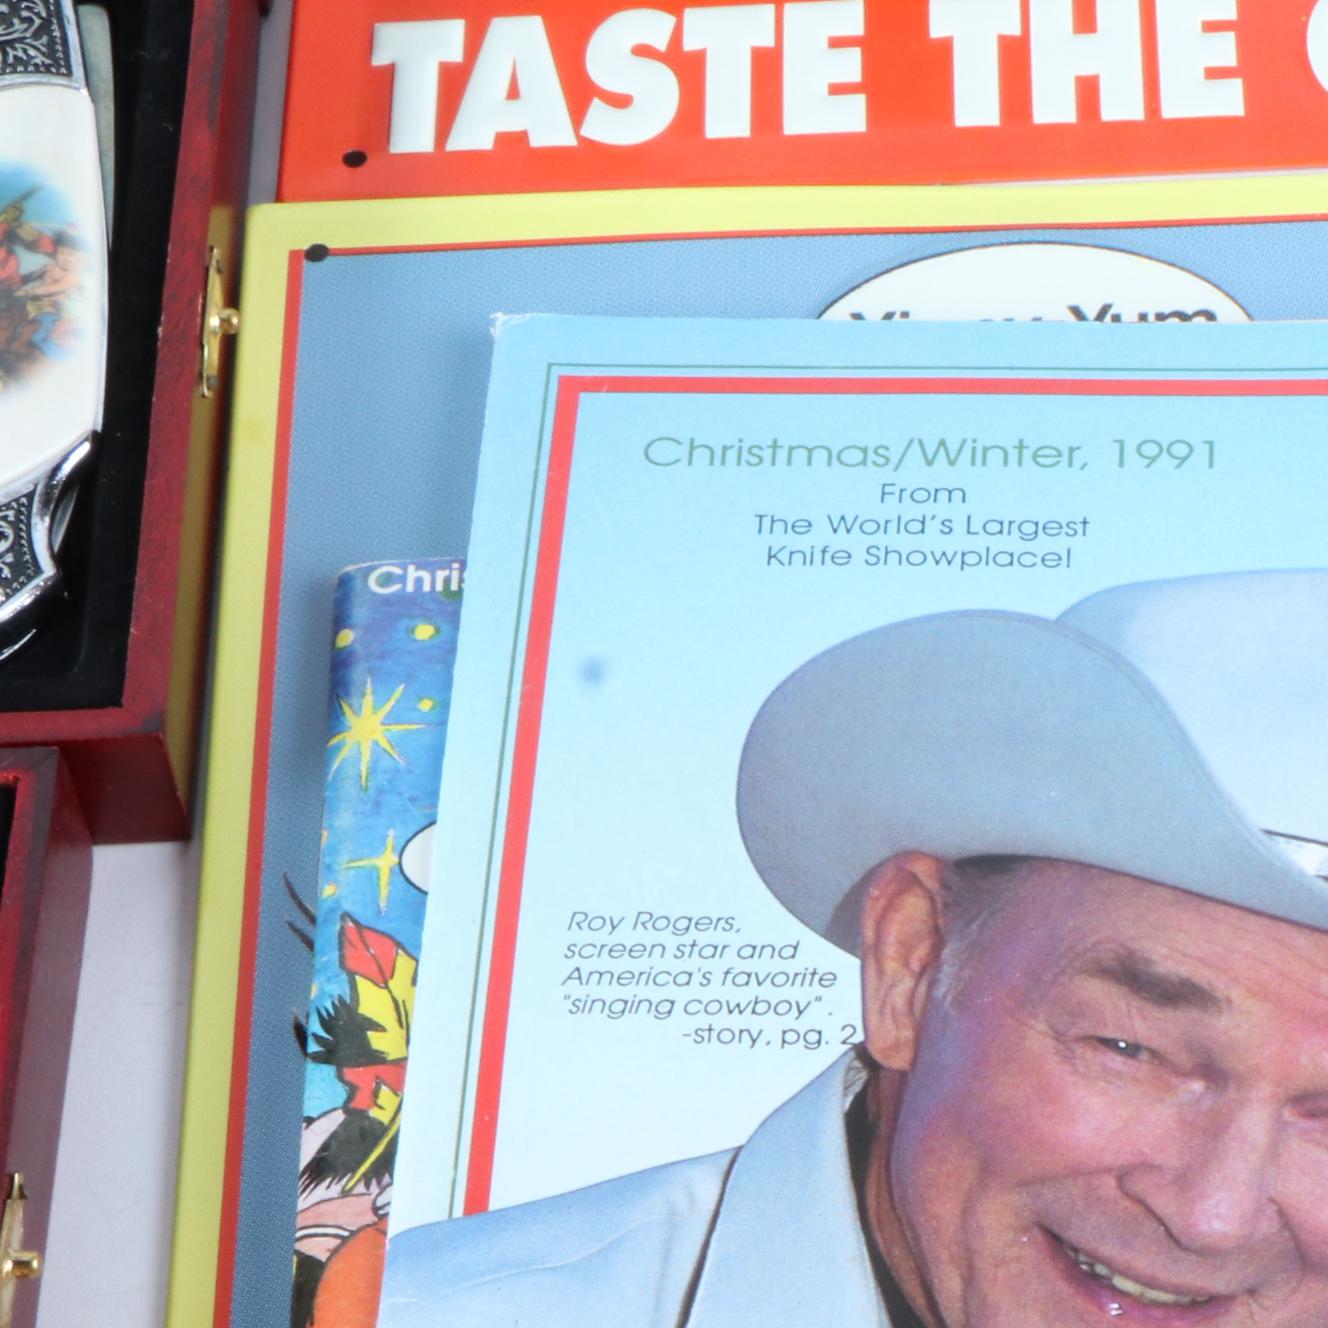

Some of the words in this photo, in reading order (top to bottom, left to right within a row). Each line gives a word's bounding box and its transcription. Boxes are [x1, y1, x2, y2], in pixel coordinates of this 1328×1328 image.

[371, 0, 868, 153] TASTE
[928, 0, 1245, 126] THE
[643, 436, 1089, 472] Christmas/Winter,
[1113, 439, 1216, 469] 1991
[880, 482, 967, 504] From
[754, 514, 812, 535] The
[827, 513, 954, 536] World's
[966, 514, 1090, 541] Largest
[766, 545, 852, 567] Knife
[864, 545, 1072, 571] Showplace!
[368, 562, 464, 594] Chri
[567, 911, 625, 935] Roy
[632, 911, 741, 936] Rogers,
[564, 943, 666, 959] screen
[673, 940, 730, 959] star
[736, 940, 800, 960] and
[561, 966, 712, 987] America's
[718, 966, 838, 988] favorite
[563, 994, 675, 1019] "singing
[682, 1023, 772, 1049] -story,
[780, 1027, 830, 1050] pg.
[840, 1024, 857, 1045] 2
